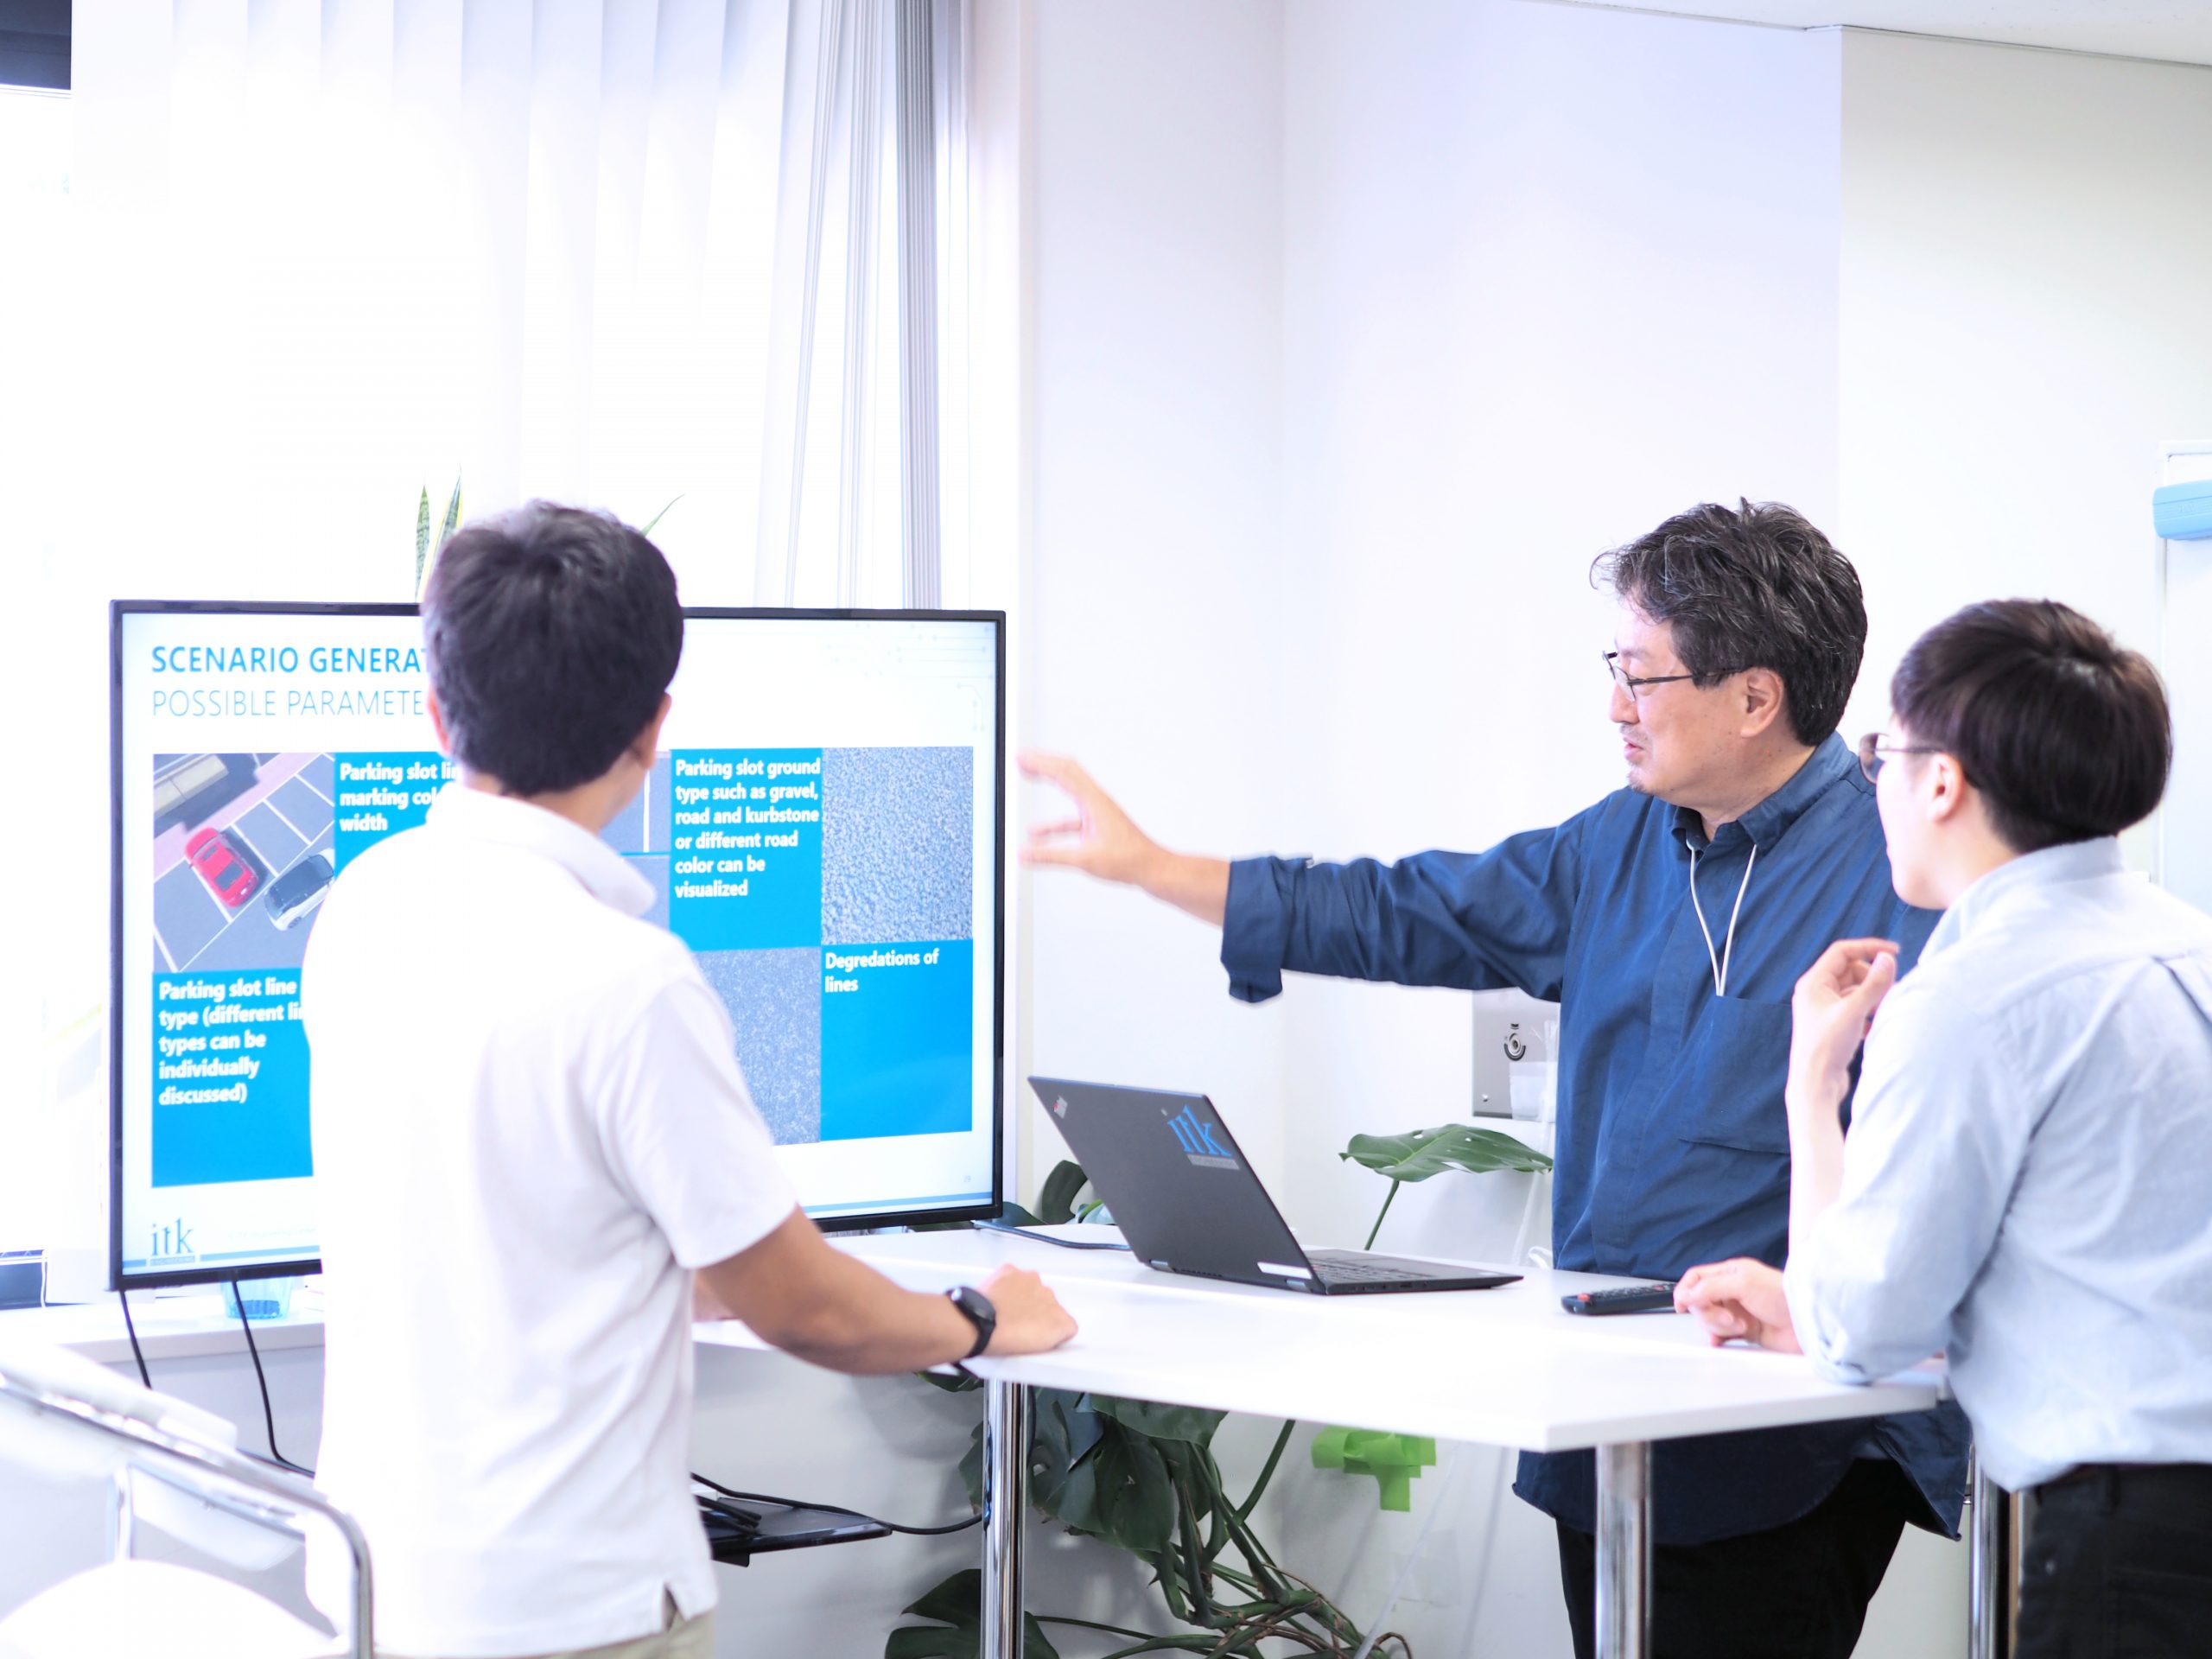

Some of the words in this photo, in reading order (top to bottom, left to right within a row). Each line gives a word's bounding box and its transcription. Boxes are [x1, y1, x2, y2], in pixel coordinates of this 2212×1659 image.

[151, 645, 299, 673] SCENARIO
[308, 646, 428, 673] GENERA
[153, 690, 276, 716] POSSIBLE
[289, 690, 423, 715] PARAMETE
[340, 762, 403, 785] Parking
[407, 762, 437, 779] slot
[676, 759, 733, 779] Parking
[736, 759, 764, 775] slot
[767, 758, 822, 779] ground
[340, 788, 409, 810] marking
[412, 787, 437, 807] col
[675, 785, 709, 804] type
[713, 782, 747, 800] such
[750, 787, 766, 799] as
[769, 781, 818, 803] gravel,
[340, 813, 388, 831] width
[676, 807, 710, 824] road
[714, 806, 741, 823] and
[746, 806, 819, 823] kurbstone
[675, 837, 692, 849] or
[696, 831, 761, 849] different
[765, 830, 798, 847] road
[675, 856, 714, 874] color
[717, 860, 743, 872] can
[747, 855, 766, 871] be
[675, 879, 748, 898] visualized
[826, 950, 920, 972] Degredations
[924, 948, 939, 964] of
[160, 981, 226, 1002] Parking
[229, 978, 262, 997] slot
[265, 977, 297, 995] line
[825, 976, 858, 992] lines
[159, 1010, 199, 1031] type
[203, 1003, 284, 1027] (different
[159, 1037, 207, 1055] types
[210, 1035, 240, 1050] can
[245, 1030, 266, 1048] be
[159, 1056, 260, 1078] individually
[159, 1083, 247, 1105] discussed)
[1161, 1104, 1231, 1156] itk
[151, 1217, 194, 1255] itk
